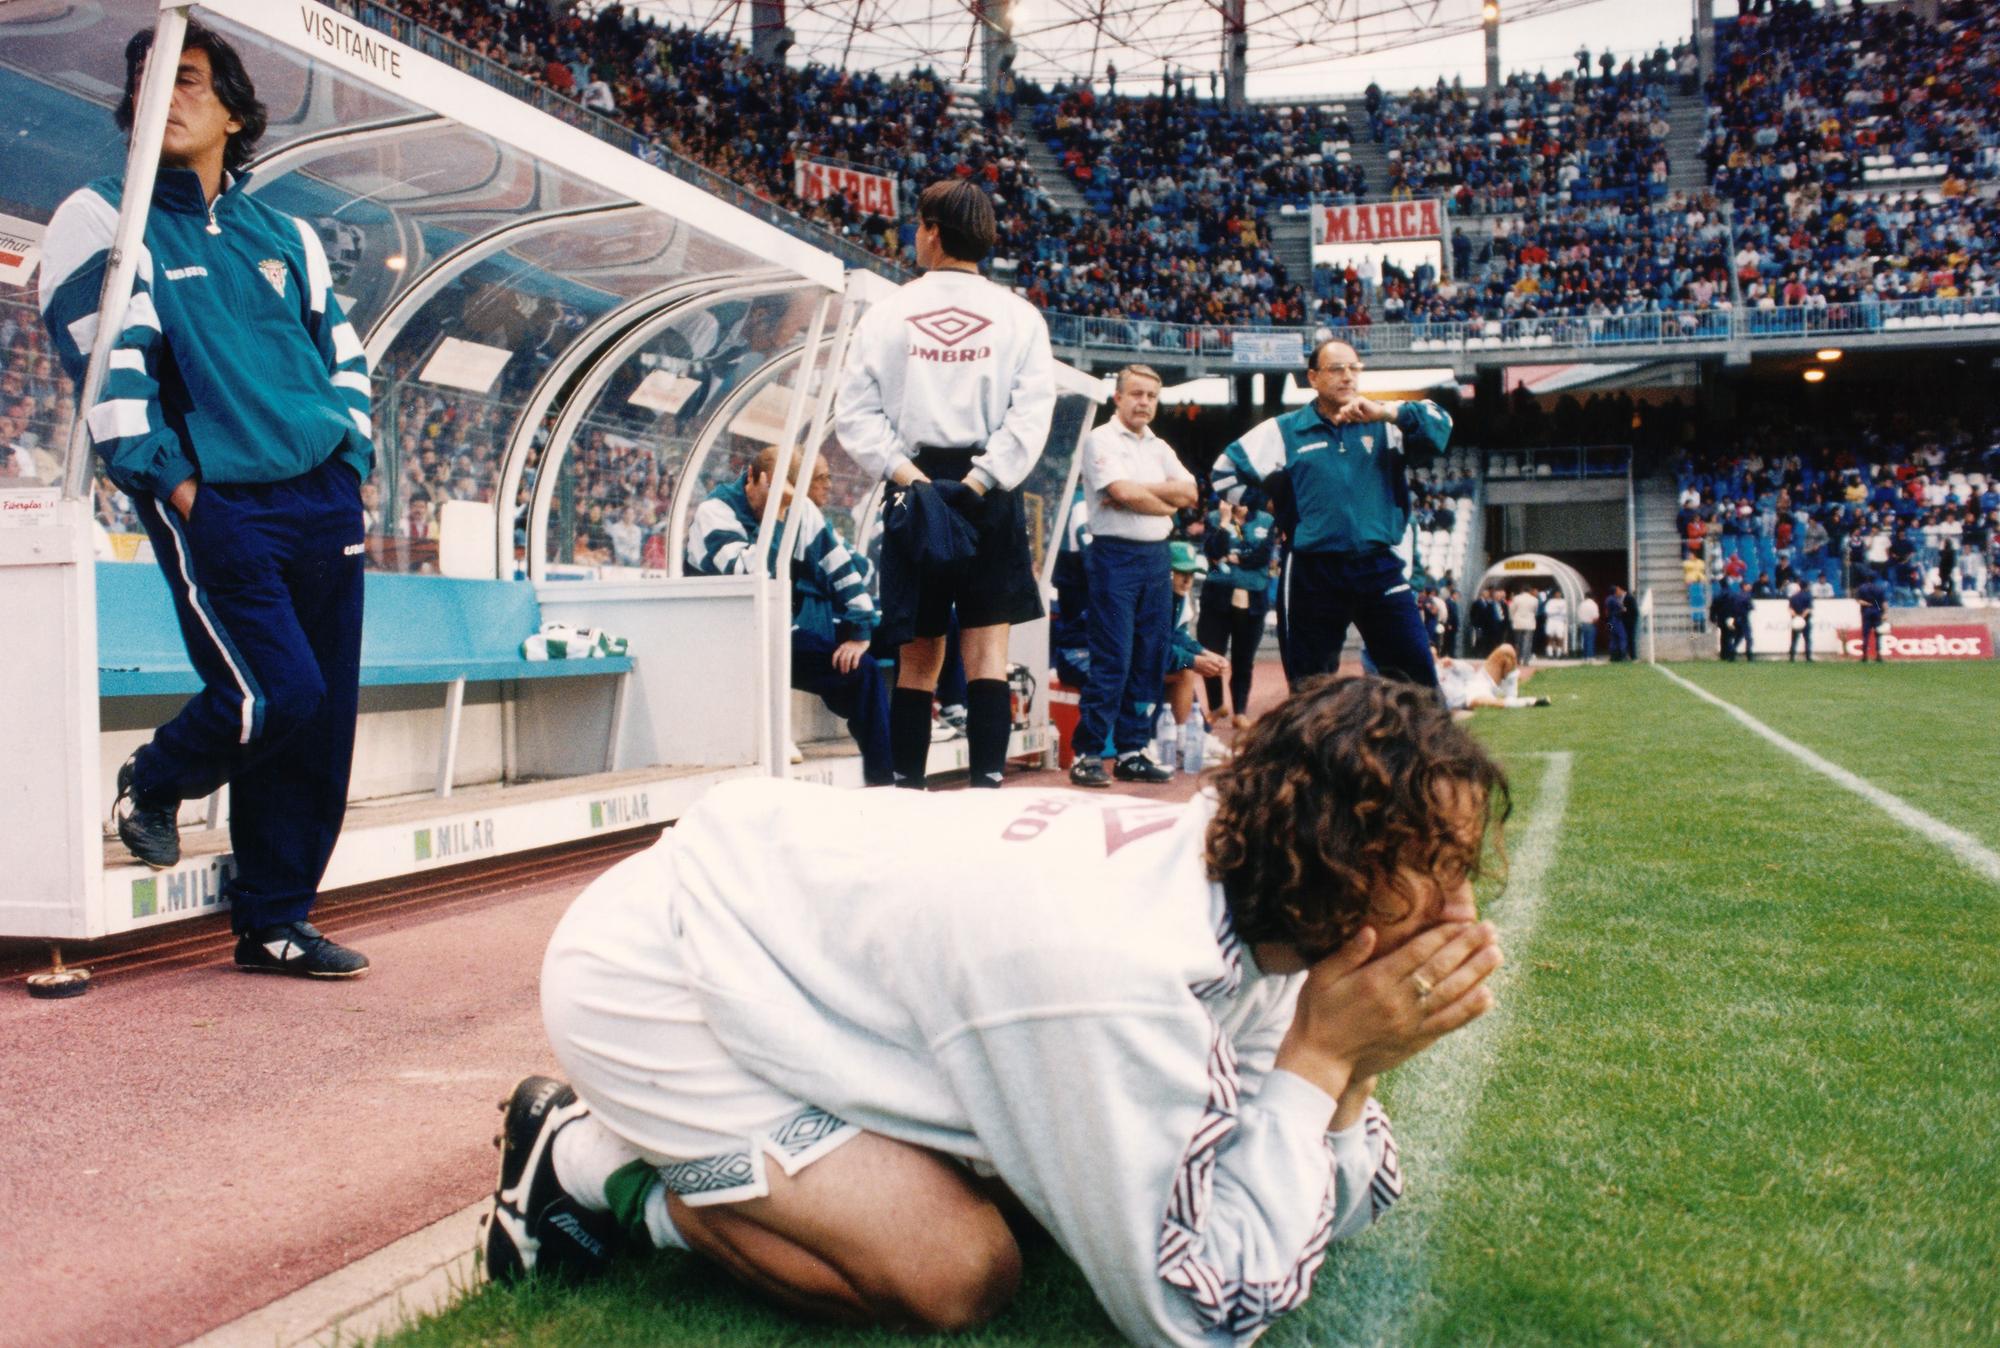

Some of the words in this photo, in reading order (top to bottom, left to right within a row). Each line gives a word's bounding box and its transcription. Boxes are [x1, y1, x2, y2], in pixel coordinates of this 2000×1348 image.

[301, 5, 401, 79] VISITANTE
[1325, 200, 1440, 243] MARCA
[0, 237, 31, 252] thur
[1878, 634, 1981, 656] Pastor
[607, 793, 650, 824] MILAR
[438, 818, 494, 857] MILAR
[167, 862, 233, 912] MILA
